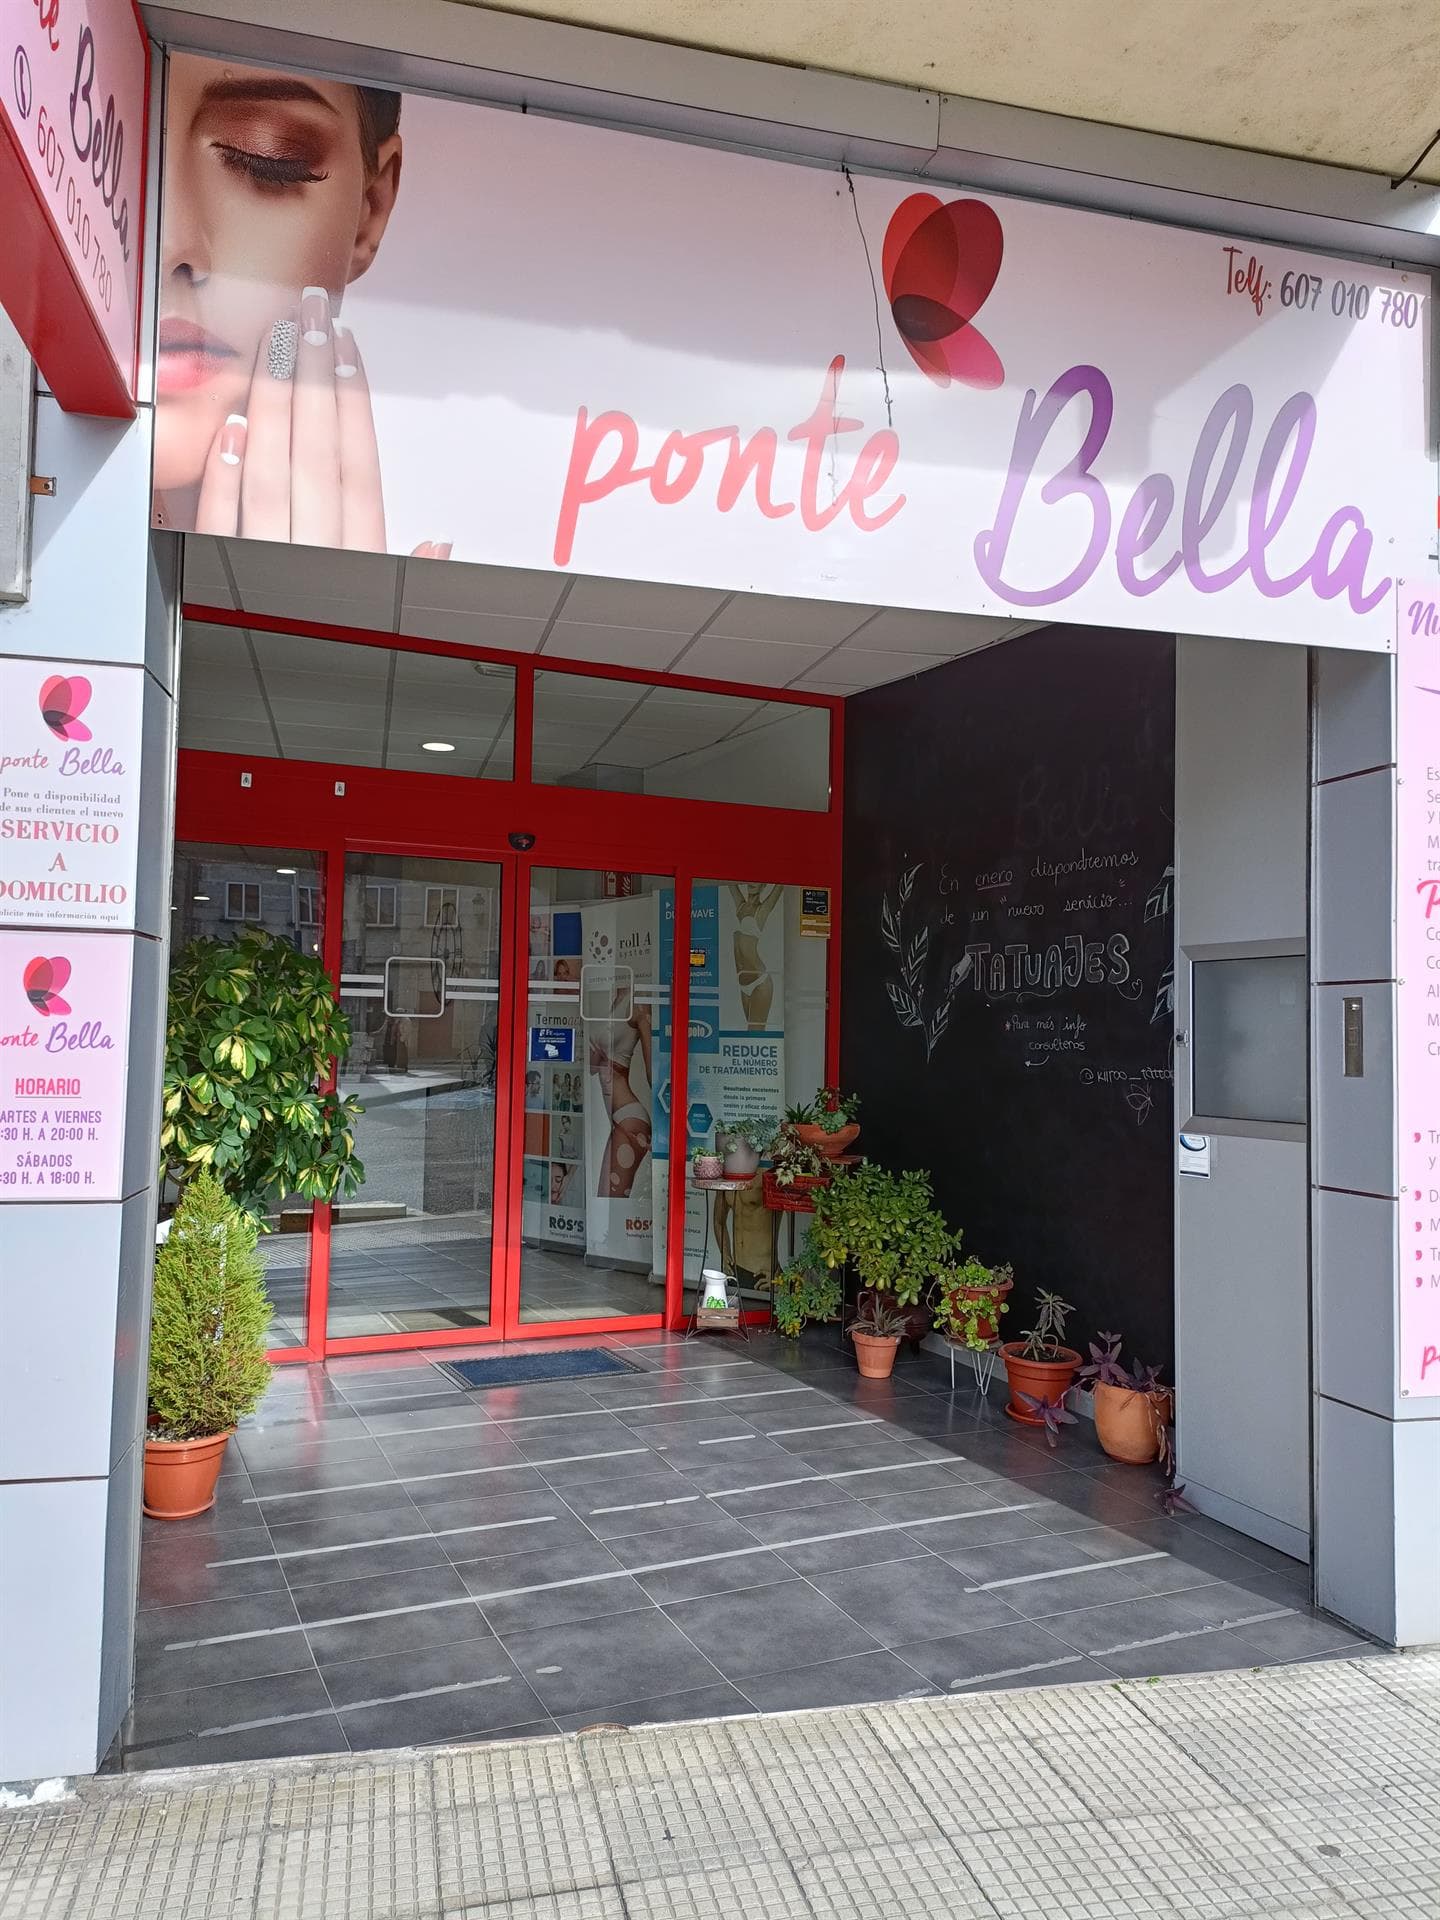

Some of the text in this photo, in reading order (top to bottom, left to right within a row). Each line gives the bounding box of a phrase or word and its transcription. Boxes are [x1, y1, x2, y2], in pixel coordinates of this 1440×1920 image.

[70, 24, 130, 262] Bella
[38, 105, 112, 312] 607 010 780
[1223, 246, 1418, 328] Telf: 607 010 780
[553, 354, 1392, 614] ponte Bella
[0, 747, 127, 776] ponte Bella
[3, 787, 29, 798] Pone
[45, 790, 121, 804] disponibilidad
[15, 805, 32, 813] sus
[36, 804, 76, 815] clientes
[80, 807, 88, 816] el
[93, 809, 124, 818] nuevo
[1, 819, 119, 844] SERVICIO
[48, 852, 68, 872] A
[939, 848, 1139, 895] En enero dispondremos
[940, 906, 955, 925] de
[970, 910, 990, 923] un
[1007, 904, 1045, 918] nuevo
[619, 932, 640, 949] roll
[965, 933, 1131, 992] TATUAJES
[1036, 1015, 1055, 1031] más
[1062, 1013, 1087, 1039] info
[45, 1021, 115, 1053] Bella
[722, 1045, 777, 1058] REDUCE
[699, 1065, 778, 1076] DE TRATAMIENTOS
[732, 1057, 777, 1067] EL NÚMERO
[15, 1078, 81, 1096] HORARIO
[42, 1110, 49, 1123] A
[55, 1110, 102, 1123] VIERNES
[23, 1127, 33, 1141] H.
[38, 1128, 45, 1141] A
[51, 1127, 83, 1141] 20:00
[88, 1127, 98, 1141] H.
[16, 1151, 73, 1167] SÁBADOS
[21, 1171, 32, 1184] H.
[37, 1171, 45, 1184] A
[50, 1171, 80, 1184] 18:00
[84, 1171, 95, 1184] H.
[548, 1214, 585, 1233] RÖS'S
